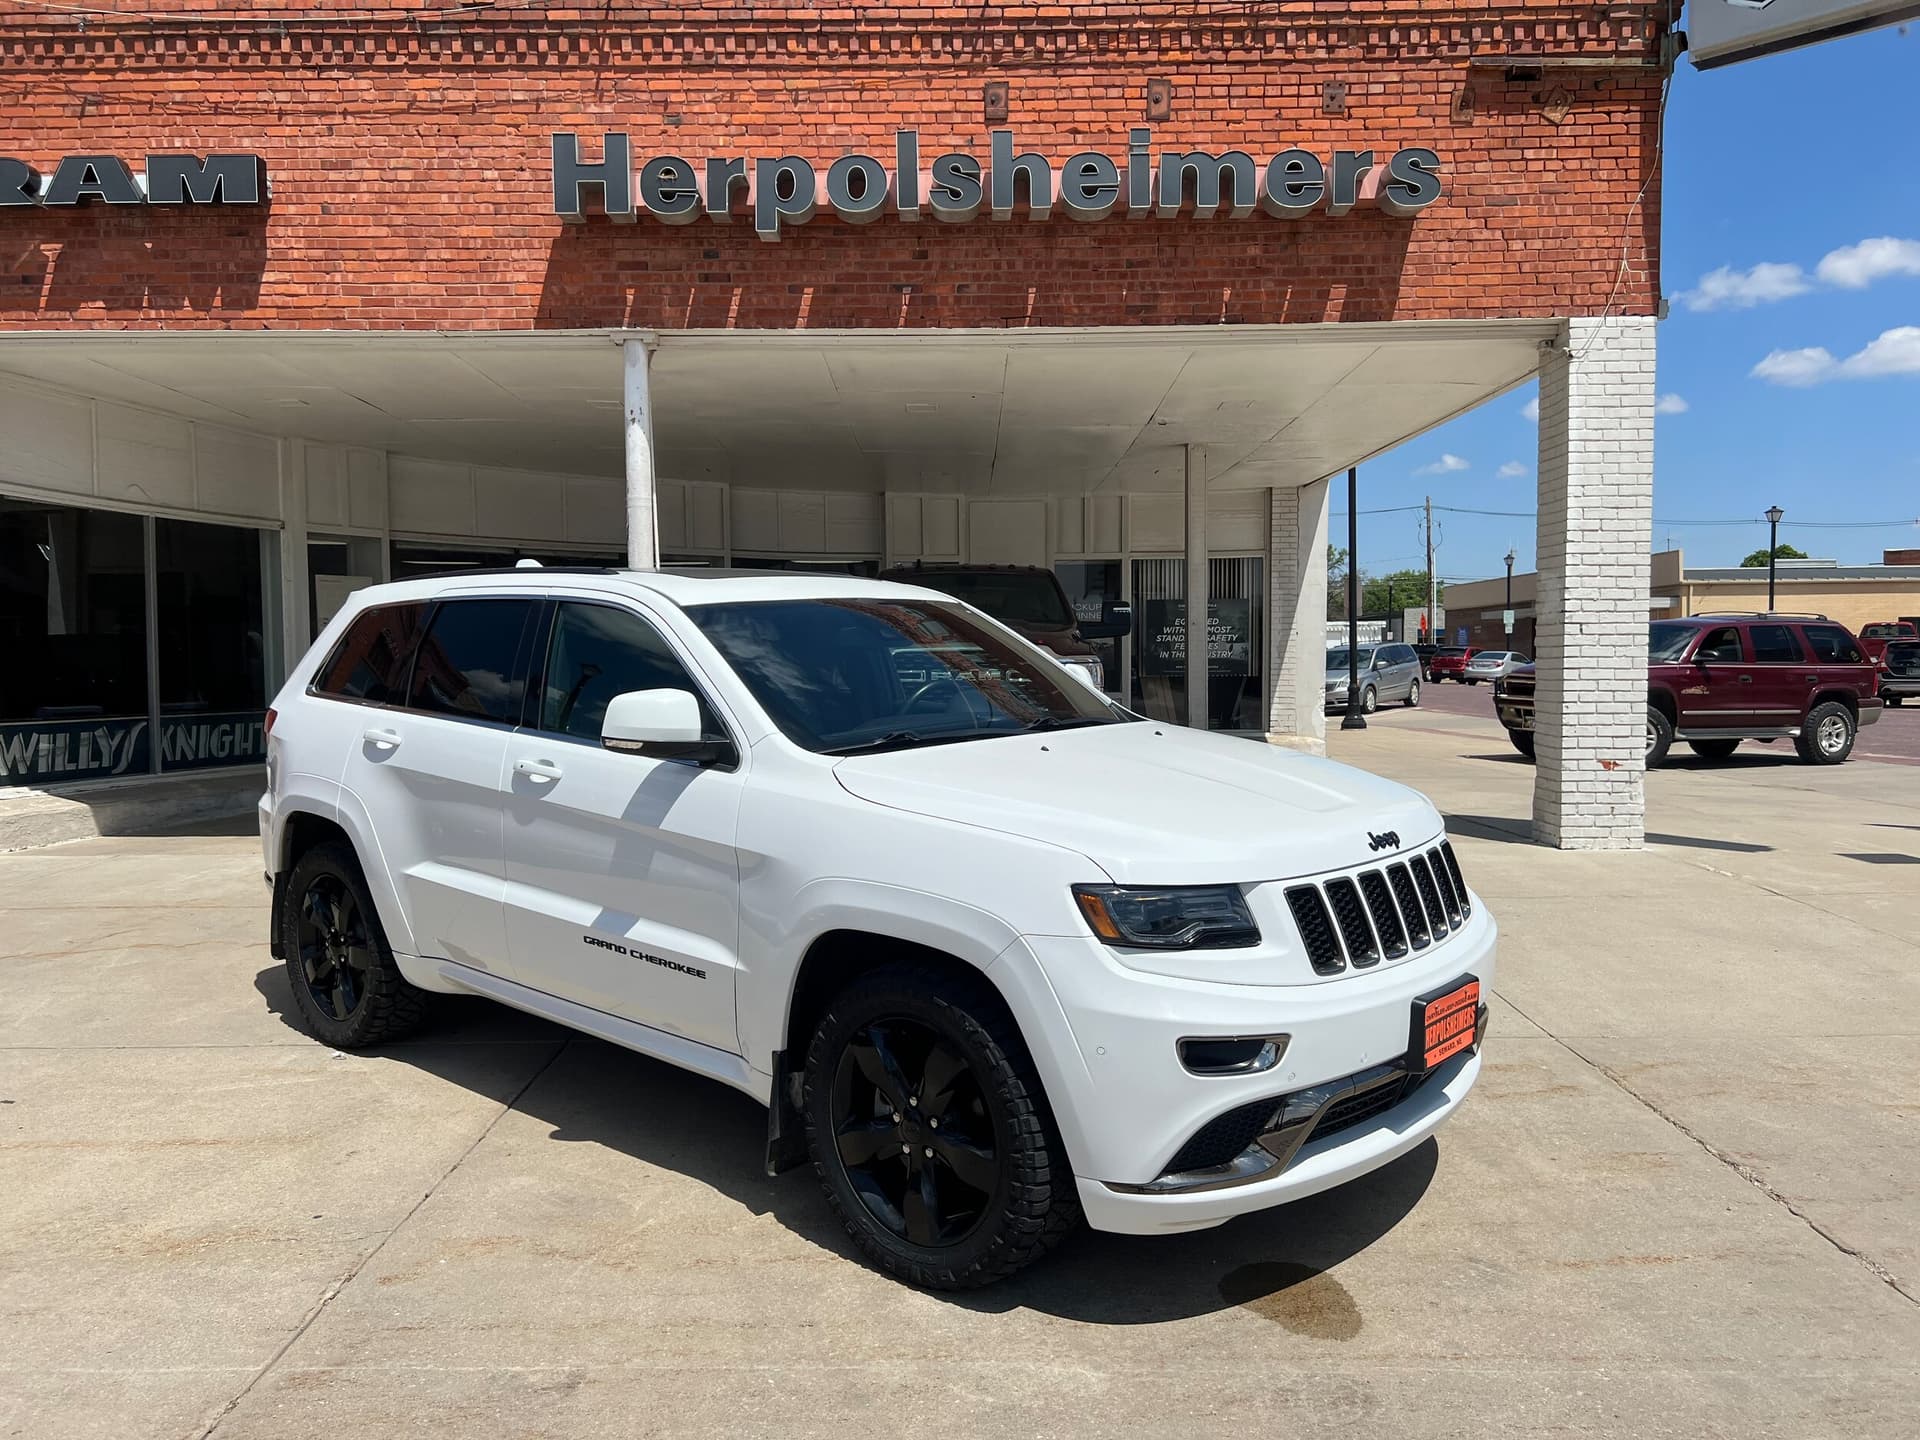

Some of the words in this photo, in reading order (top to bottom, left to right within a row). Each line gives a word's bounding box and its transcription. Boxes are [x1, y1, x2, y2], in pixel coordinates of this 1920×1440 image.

[551, 128, 1441, 235] Herpolsheimers
[1159, 651, 1170, 659] IN
[0, 721, 148, 776] WILLYS
[160, 722, 268, 762] KNIGHT
[1366, 830, 1401, 852] Jeep
[583, 935, 627, 955] GRAND
[630, 949, 707, 980] CHEROKEE
